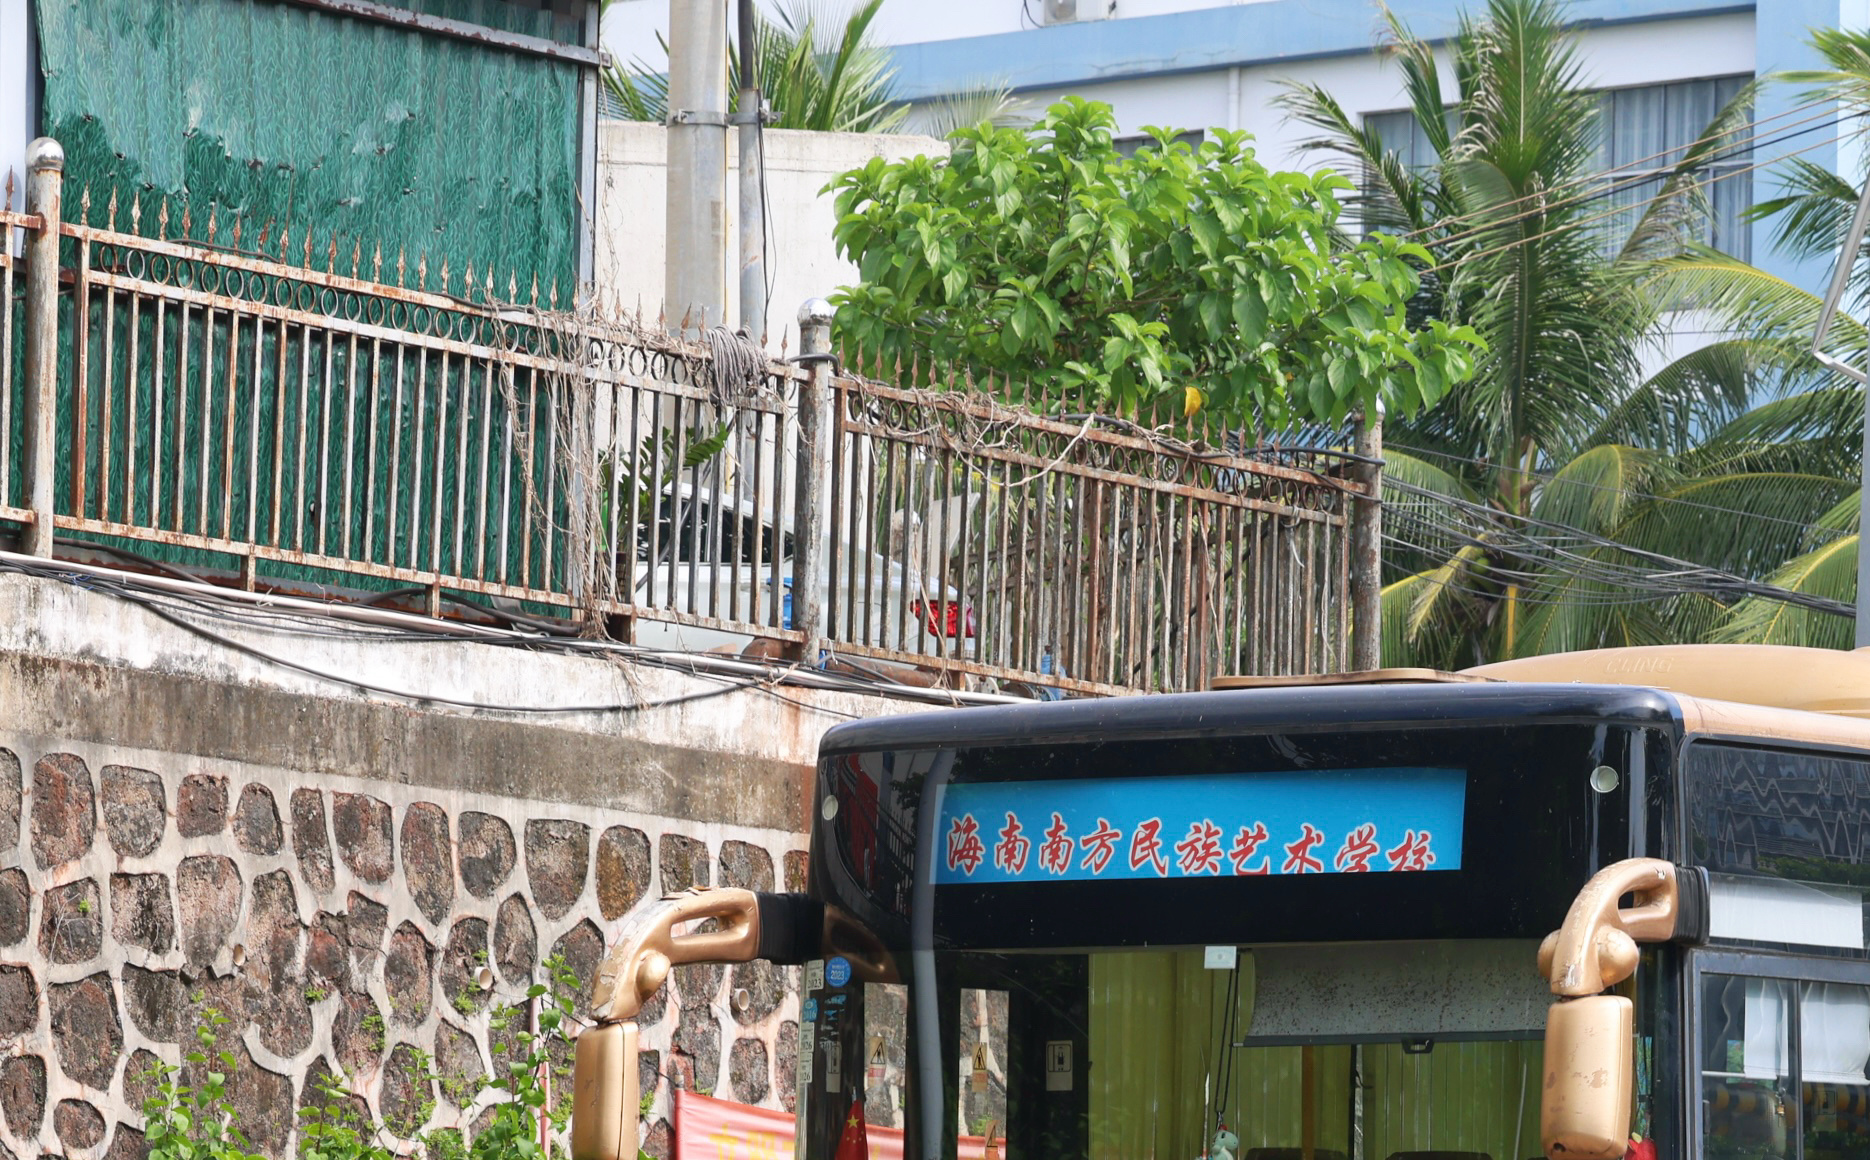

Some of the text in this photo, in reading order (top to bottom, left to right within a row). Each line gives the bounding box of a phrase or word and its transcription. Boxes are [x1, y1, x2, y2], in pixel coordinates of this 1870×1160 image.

[946, 811, 1437, 878] 海南南方民族艺术学校
